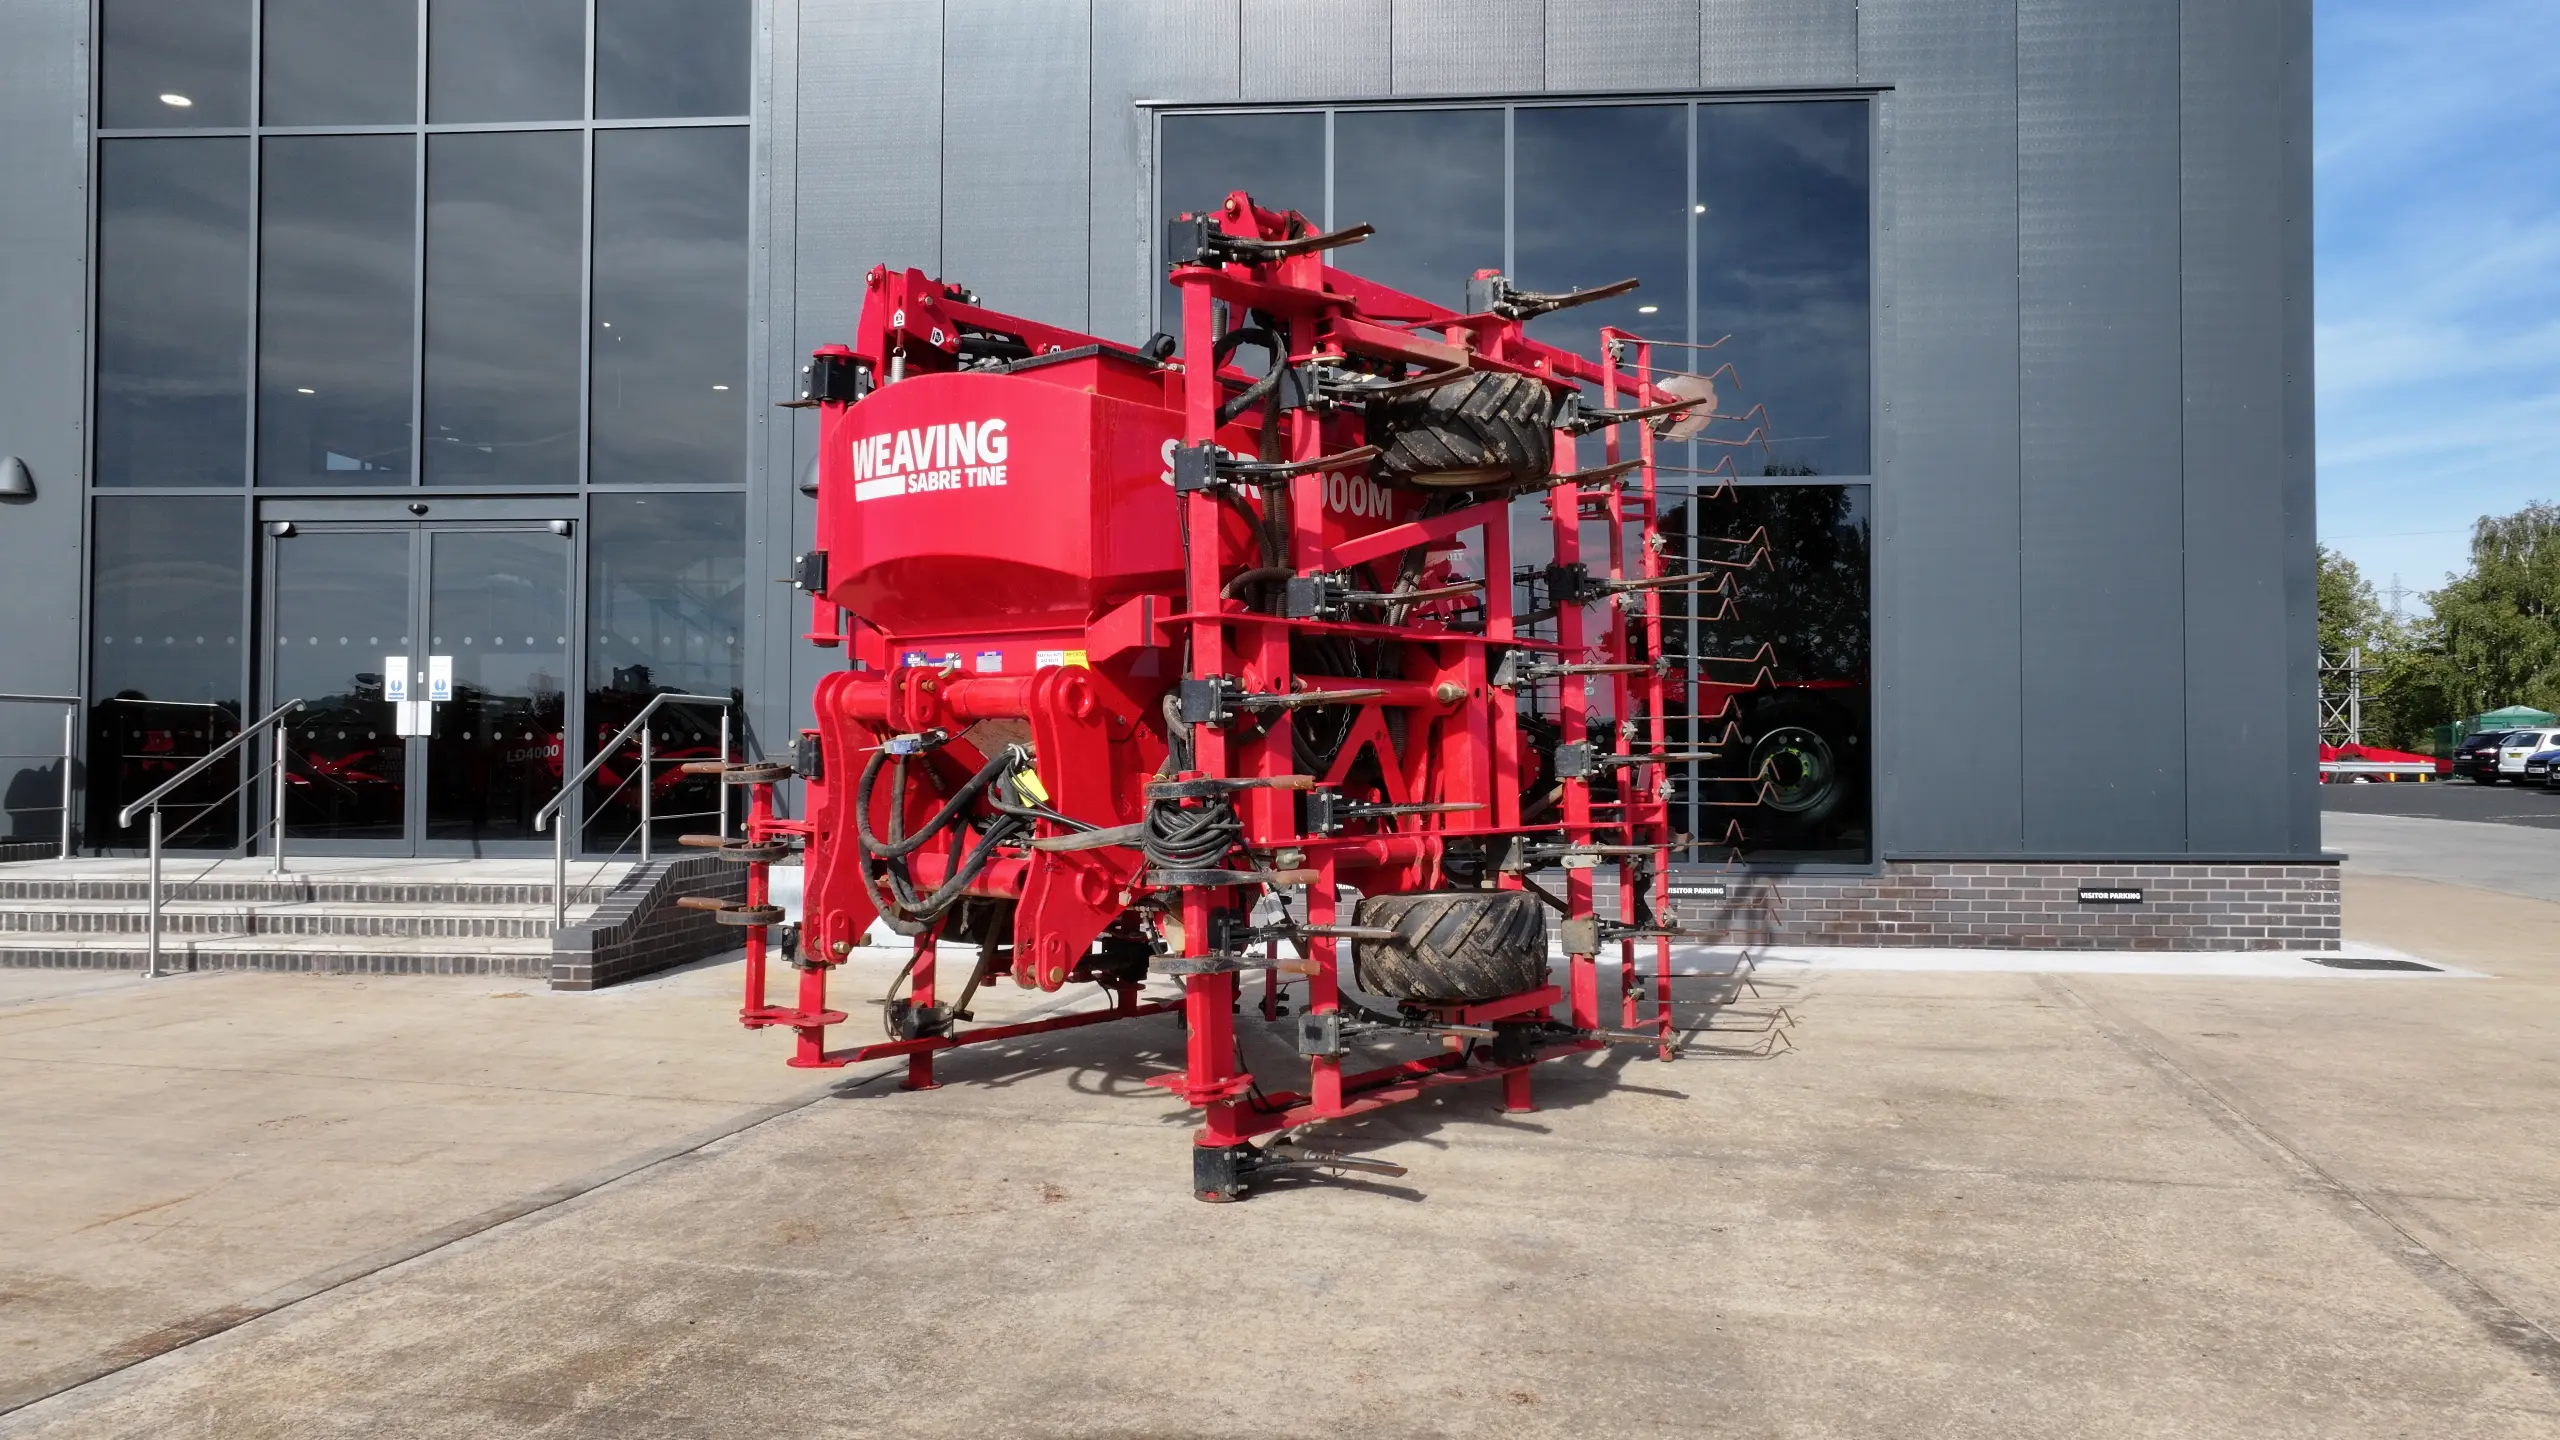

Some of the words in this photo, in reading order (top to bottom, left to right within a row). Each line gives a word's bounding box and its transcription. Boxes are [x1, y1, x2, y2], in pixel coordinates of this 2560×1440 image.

[852, 418, 1008, 481] WEAVING
[908, 468, 961, 493] SABRE
[965, 466, 1007, 487] TINE
[507, 744, 559, 763] LD4000
[1694, 887, 1725, 895] PARKING
[2110, 892, 2141, 900] PARKING
